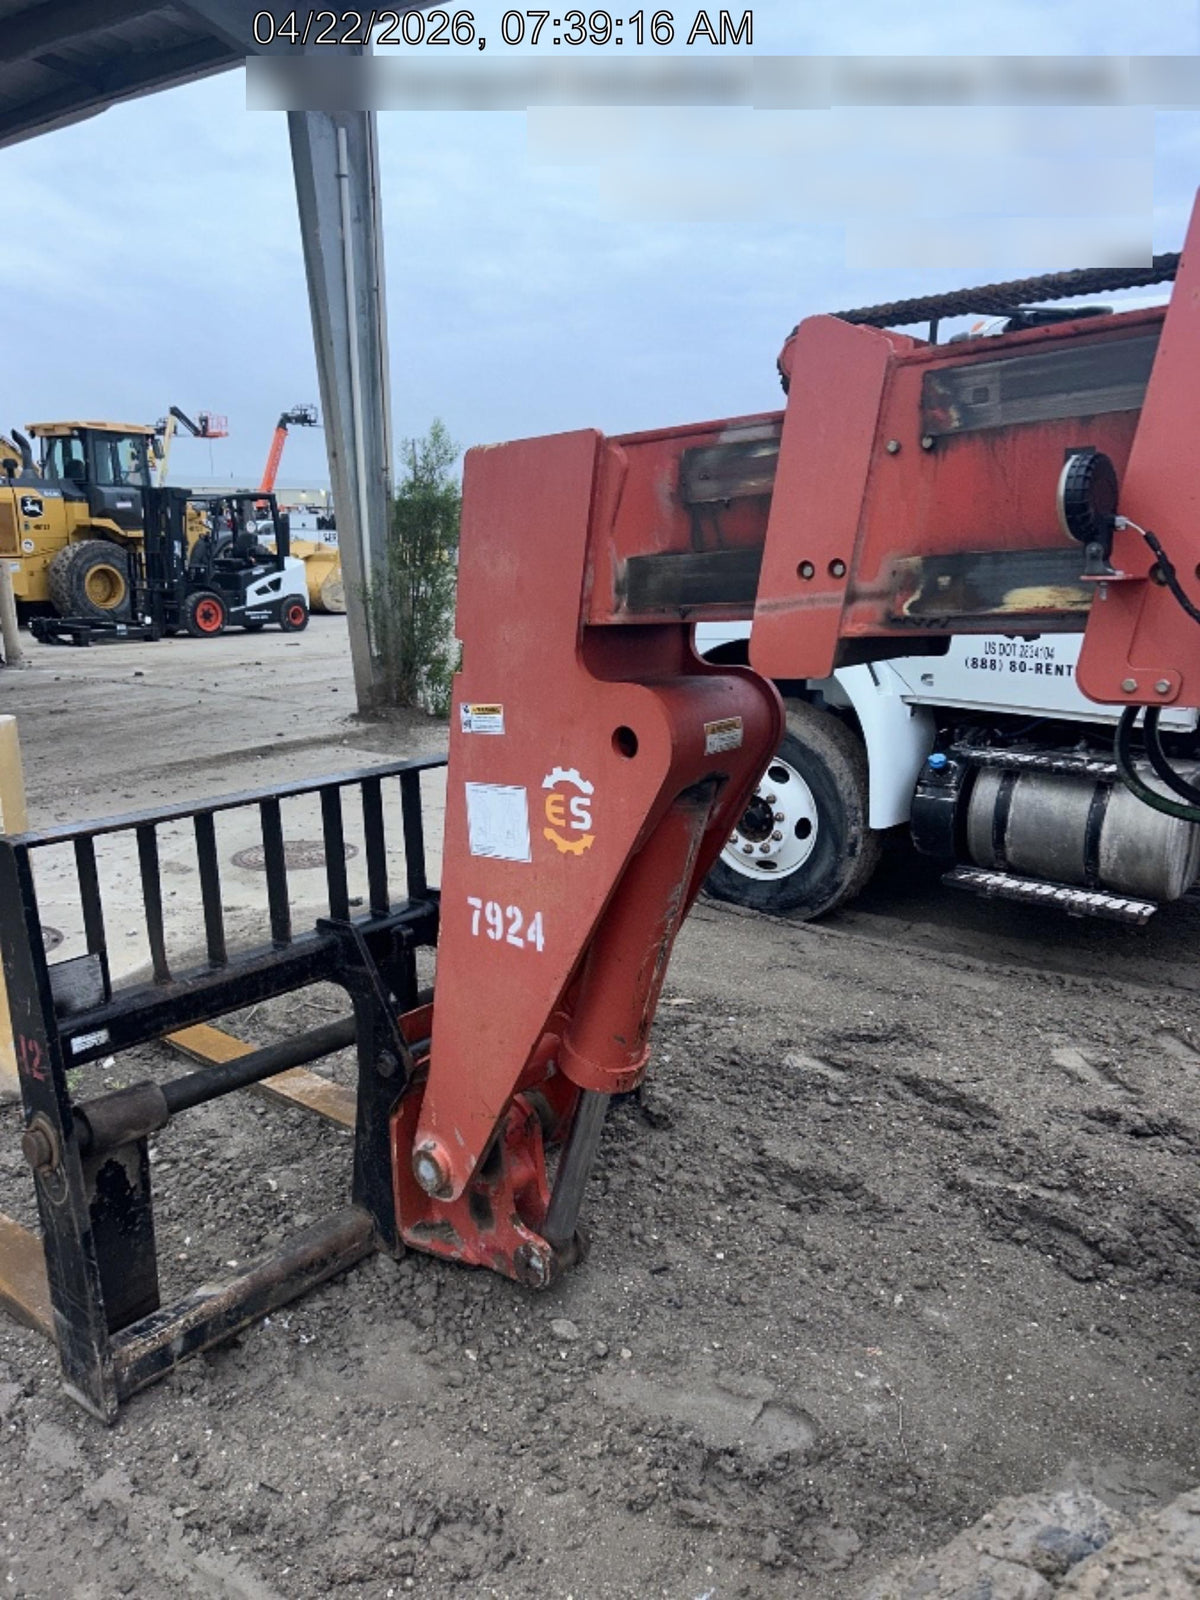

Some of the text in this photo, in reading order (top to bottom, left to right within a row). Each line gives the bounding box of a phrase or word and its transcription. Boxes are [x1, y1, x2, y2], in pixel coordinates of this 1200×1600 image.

[964, 657, 1073, 676] (888) 80-RENT
[984, 642, 997, 655] US
[999, 643, 1017, 655] DOT
[544, 793, 593, 831] ES
[466, 896, 546, 953] 7924
[18, 1034, 46, 1082] 12
